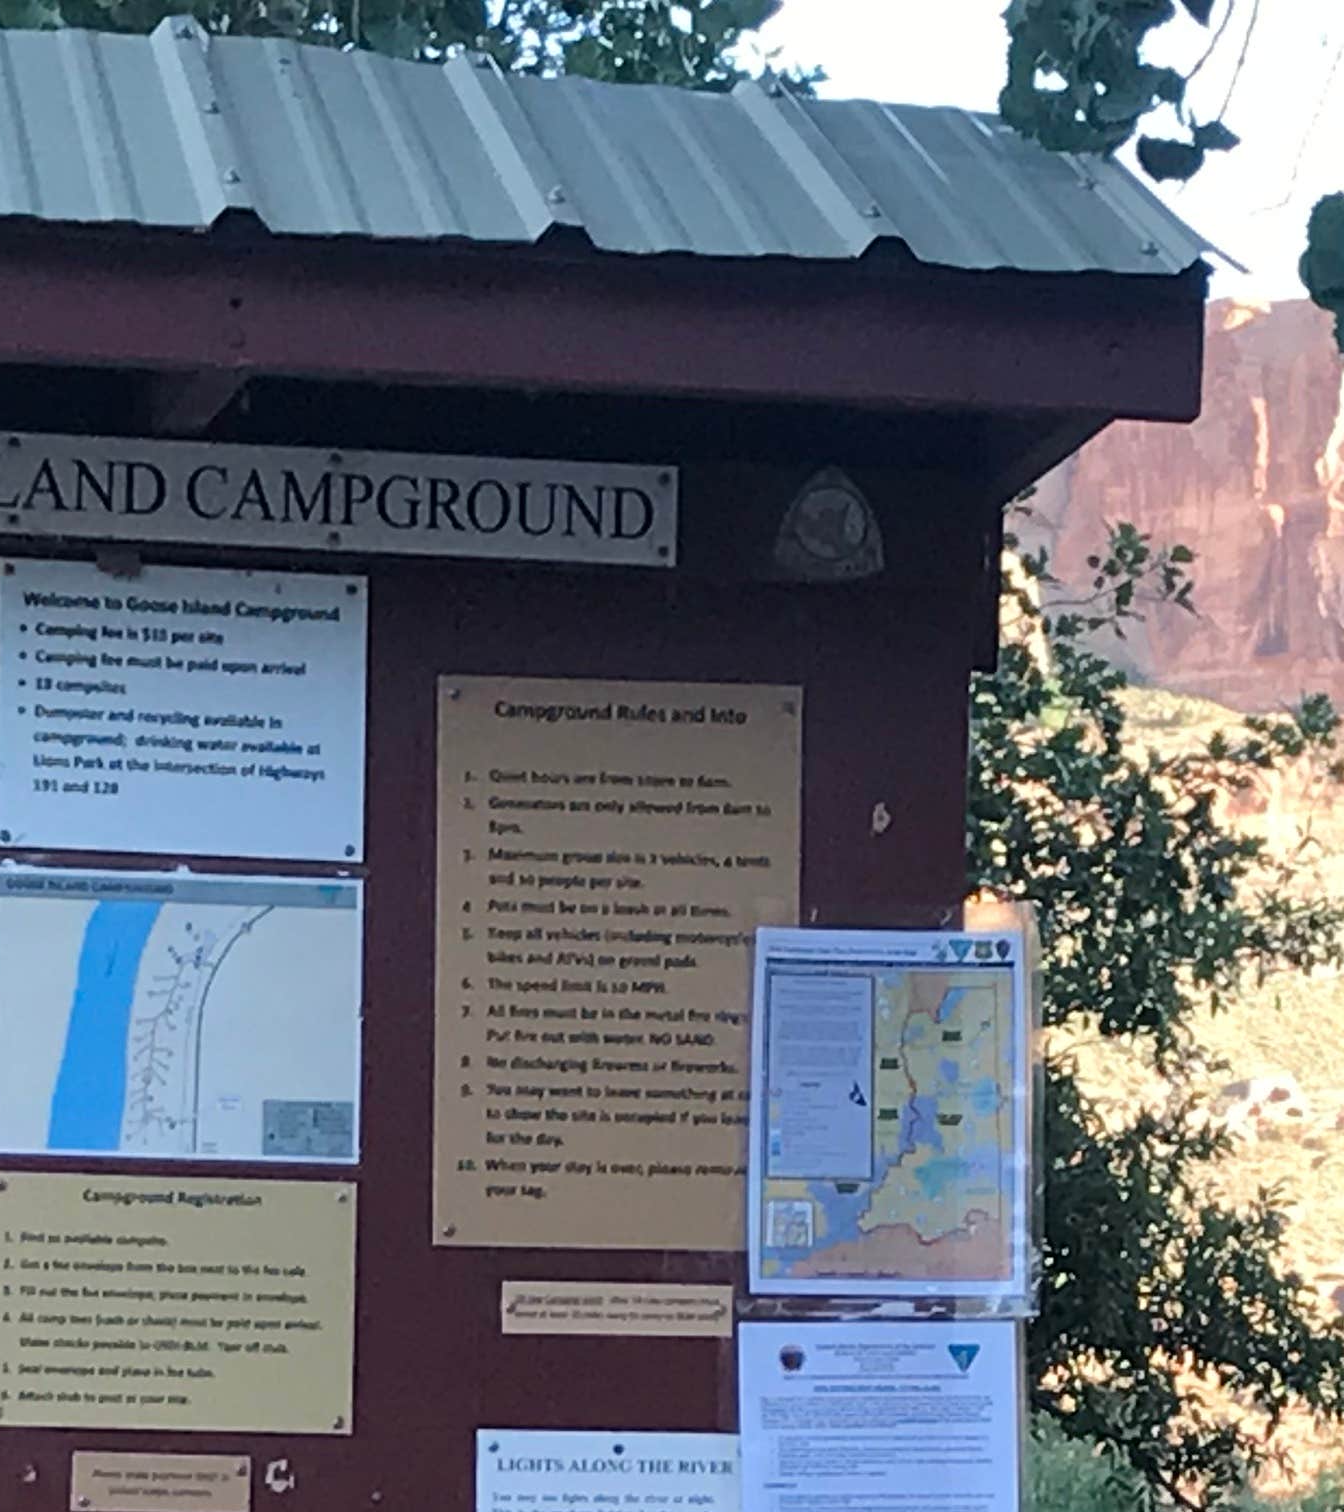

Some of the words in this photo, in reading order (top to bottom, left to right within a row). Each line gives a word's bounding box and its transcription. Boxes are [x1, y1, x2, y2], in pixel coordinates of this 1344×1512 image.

[185, 466, 655, 540] CAMPGROUND
[22, 592, 101, 610] Welcome
[103, 596, 123, 611] to
[125, 596, 179, 614] Goose
[181, 599, 231, 617] Island
[234, 602, 340, 625] Campground
[34, 621, 98, 641] Camping
[101, 625, 124, 640] fee
[126, 627, 139, 640] is
[170, 631, 195, 646] per
[198, 632, 224, 645] site
[35, 649, 97, 668] Camping
[100, 652, 123, 667] fee
[126, 655, 162, 669] must
[165, 656, 184, 670] be
[186, 657, 219, 674] paid
[221, 661, 258, 676] upon
[260, 661, 306, 676] arrival
[34, 704, 105, 721] Dumpster
[107, 708, 135, 723] and
[137, 710, 200, 728] recycling
[203, 713, 265, 729] available
[268, 716, 283, 730] in
[493, 700, 612, 724] Campground
[616, 703, 666, 723] Rules
[671, 705, 706, 724] and
[710, 707, 747, 725] Info
[135, 735, 193, 752] drinking
[196, 739, 238, 752] water
[240, 740, 303, 755] available
[306, 743, 321, 756] at
[33, 754, 71, 769] Lions
[73, 755, 104, 770] Park
[108, 758, 123, 771] at
[126, 758, 150, 772] the
[153, 761, 237, 776] intersection
[240, 762, 256, 778] of
[258, 764, 325, 783] Highways
[33, 778, 58, 793] 191
[62, 780, 90, 794] and
[93, 781, 119, 795] 128
[82, 1189, 174, 1206] Campground
[177, 1192, 262, 1209] Registration
[497, 1458, 565, 1472] LIGHTS
[569, 1459, 632, 1473] ALONG
[637, 1459, 673, 1474] THE
[678, 1460, 732, 1475] RIVER
